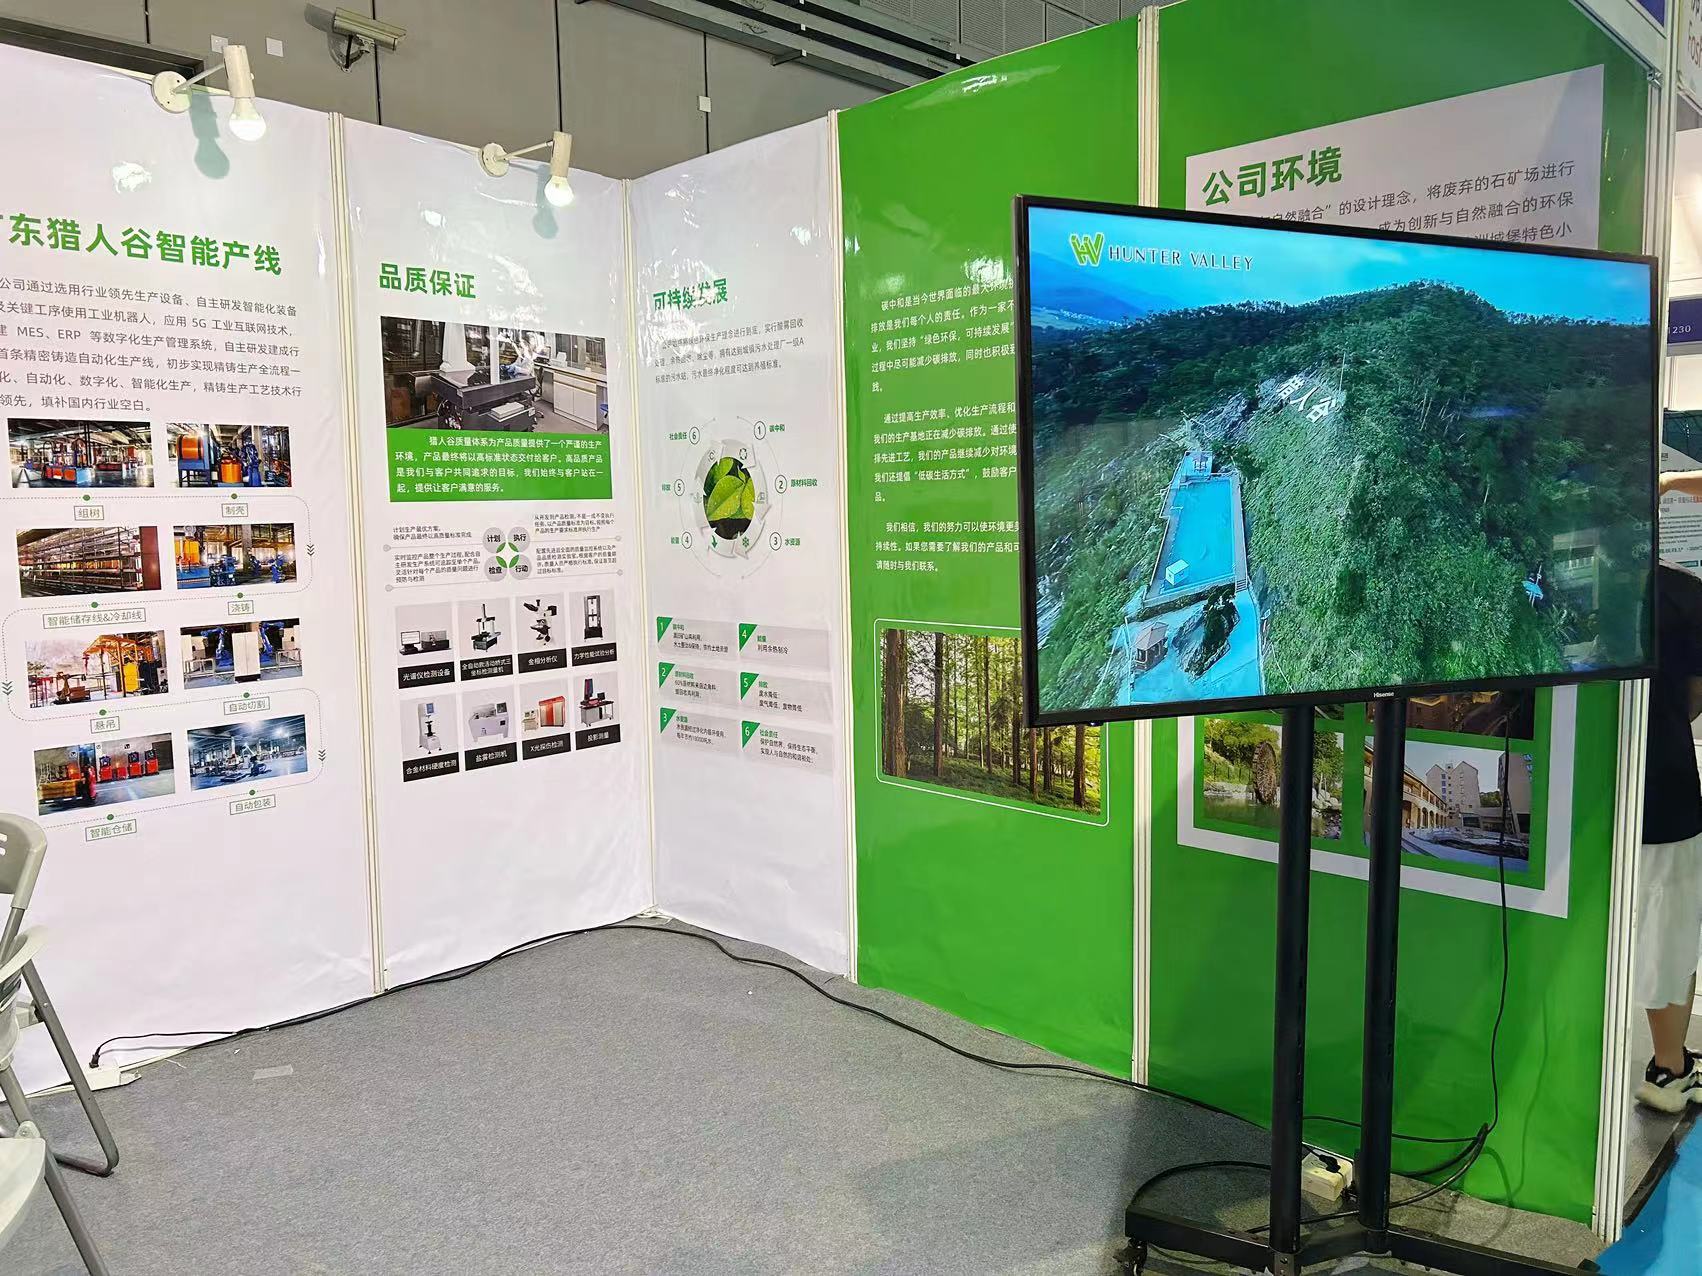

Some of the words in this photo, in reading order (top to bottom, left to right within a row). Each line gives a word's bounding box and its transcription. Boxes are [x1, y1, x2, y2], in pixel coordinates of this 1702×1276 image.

[1202, 145, 1342, 206] 公司环境
[0, 213, 282, 276] 东猎人谷智能产线
[1109, 245, 1181, 265] HUNTER
[1190, 252, 1254, 271] VALLEY
[379, 262, 476, 299] 品质保证
[0, 277, 297, 317] 公司通过选用行业领先生产设备、自主研发智能化装备
[653, 278, 728, 310] 可持续发展
[192, 317, 207, 328] 5G
[669, 432, 687, 440] 社会责任
[487, 534, 501, 543] 计划
[513, 534, 526, 542] 执行
[489, 566, 502, 575] 检查
[515, 565, 528, 573] 行动
[47, 610, 142, 626] 智能储存线&冷却线
[403, 668, 451, 681] 光谱仪检测设备
[229, 699, 266, 713] 自动切割
[588, 732, 609, 742] 投影测量
[406, 759, 457, 775] 合金材料硬度检测
[235, 798, 272, 811] 自动包装
[90, 823, 133, 839] 智能仓储
